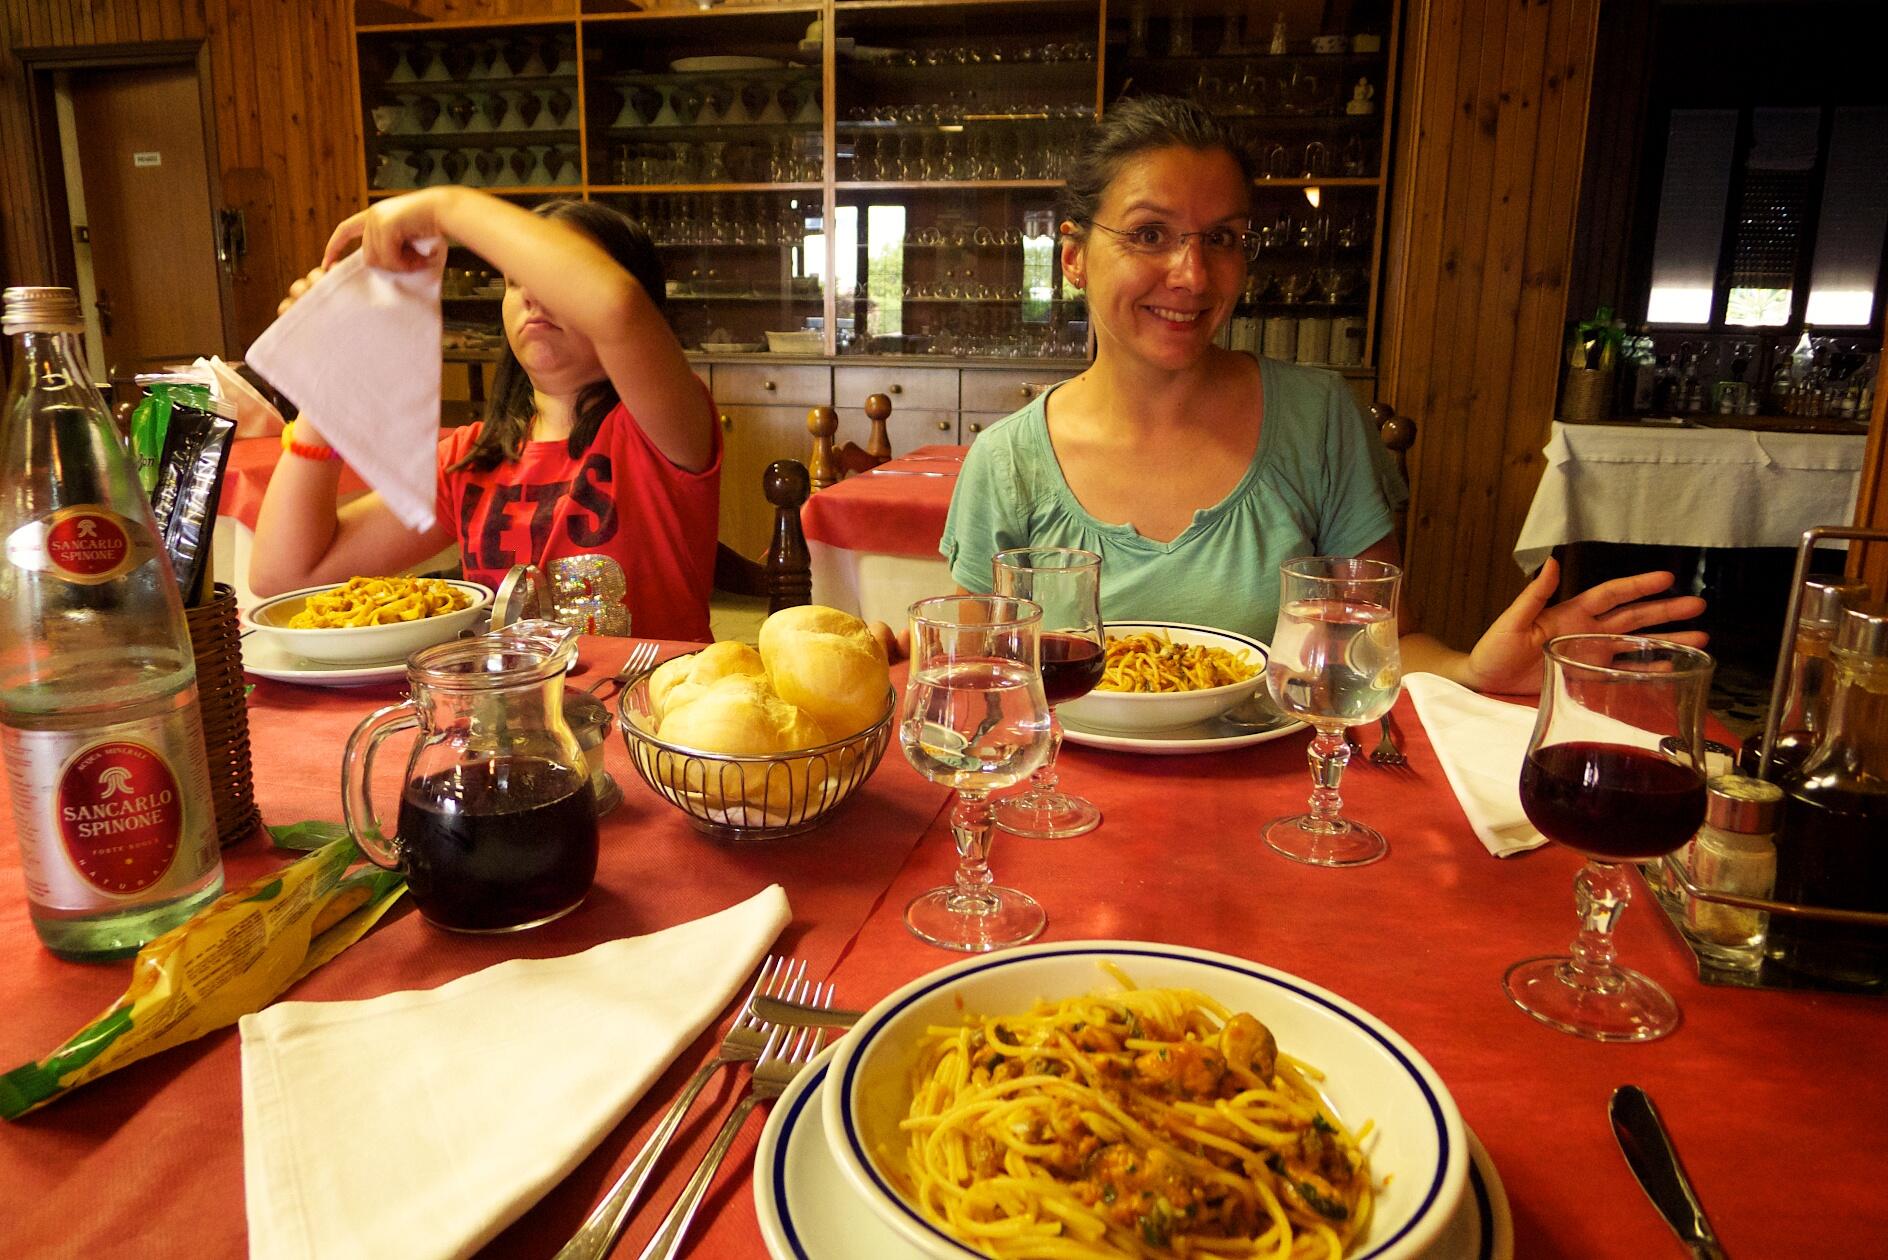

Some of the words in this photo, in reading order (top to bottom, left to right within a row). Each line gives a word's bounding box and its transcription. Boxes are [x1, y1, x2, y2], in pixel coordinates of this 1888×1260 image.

[51, 539, 123, 551] SANCARLO
[60, 549, 116, 561] SPINONE
[63, 789, 172, 822] SANCARLO
[78, 809, 164, 838] SPINONE
